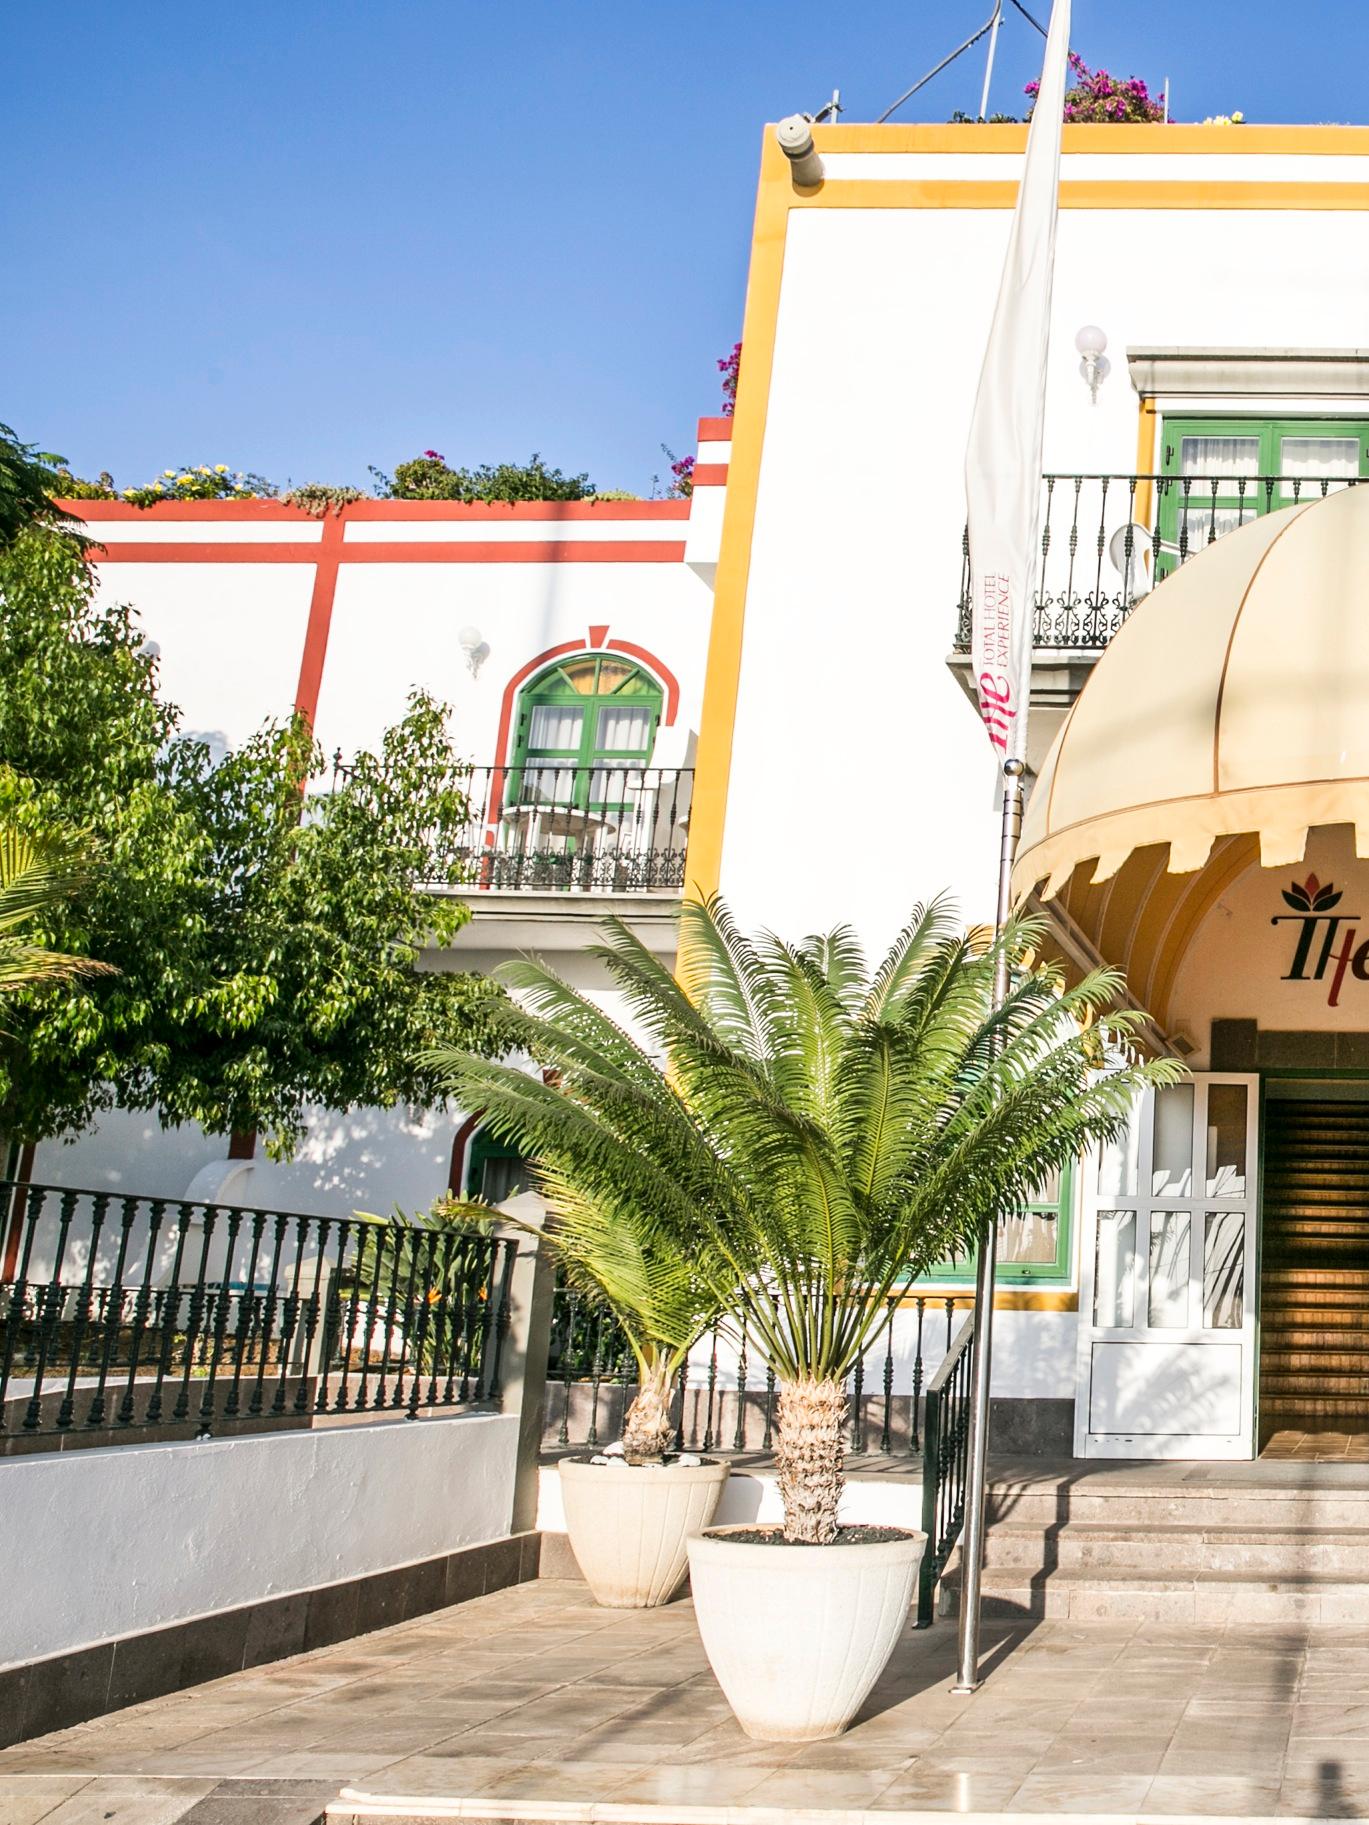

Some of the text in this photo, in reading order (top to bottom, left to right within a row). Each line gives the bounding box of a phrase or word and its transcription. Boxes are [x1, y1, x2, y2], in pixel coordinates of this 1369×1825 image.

[983, 572, 996, 666] TOTAL HOTEL
[997, 571, 1009, 668] EXPERIENCE
